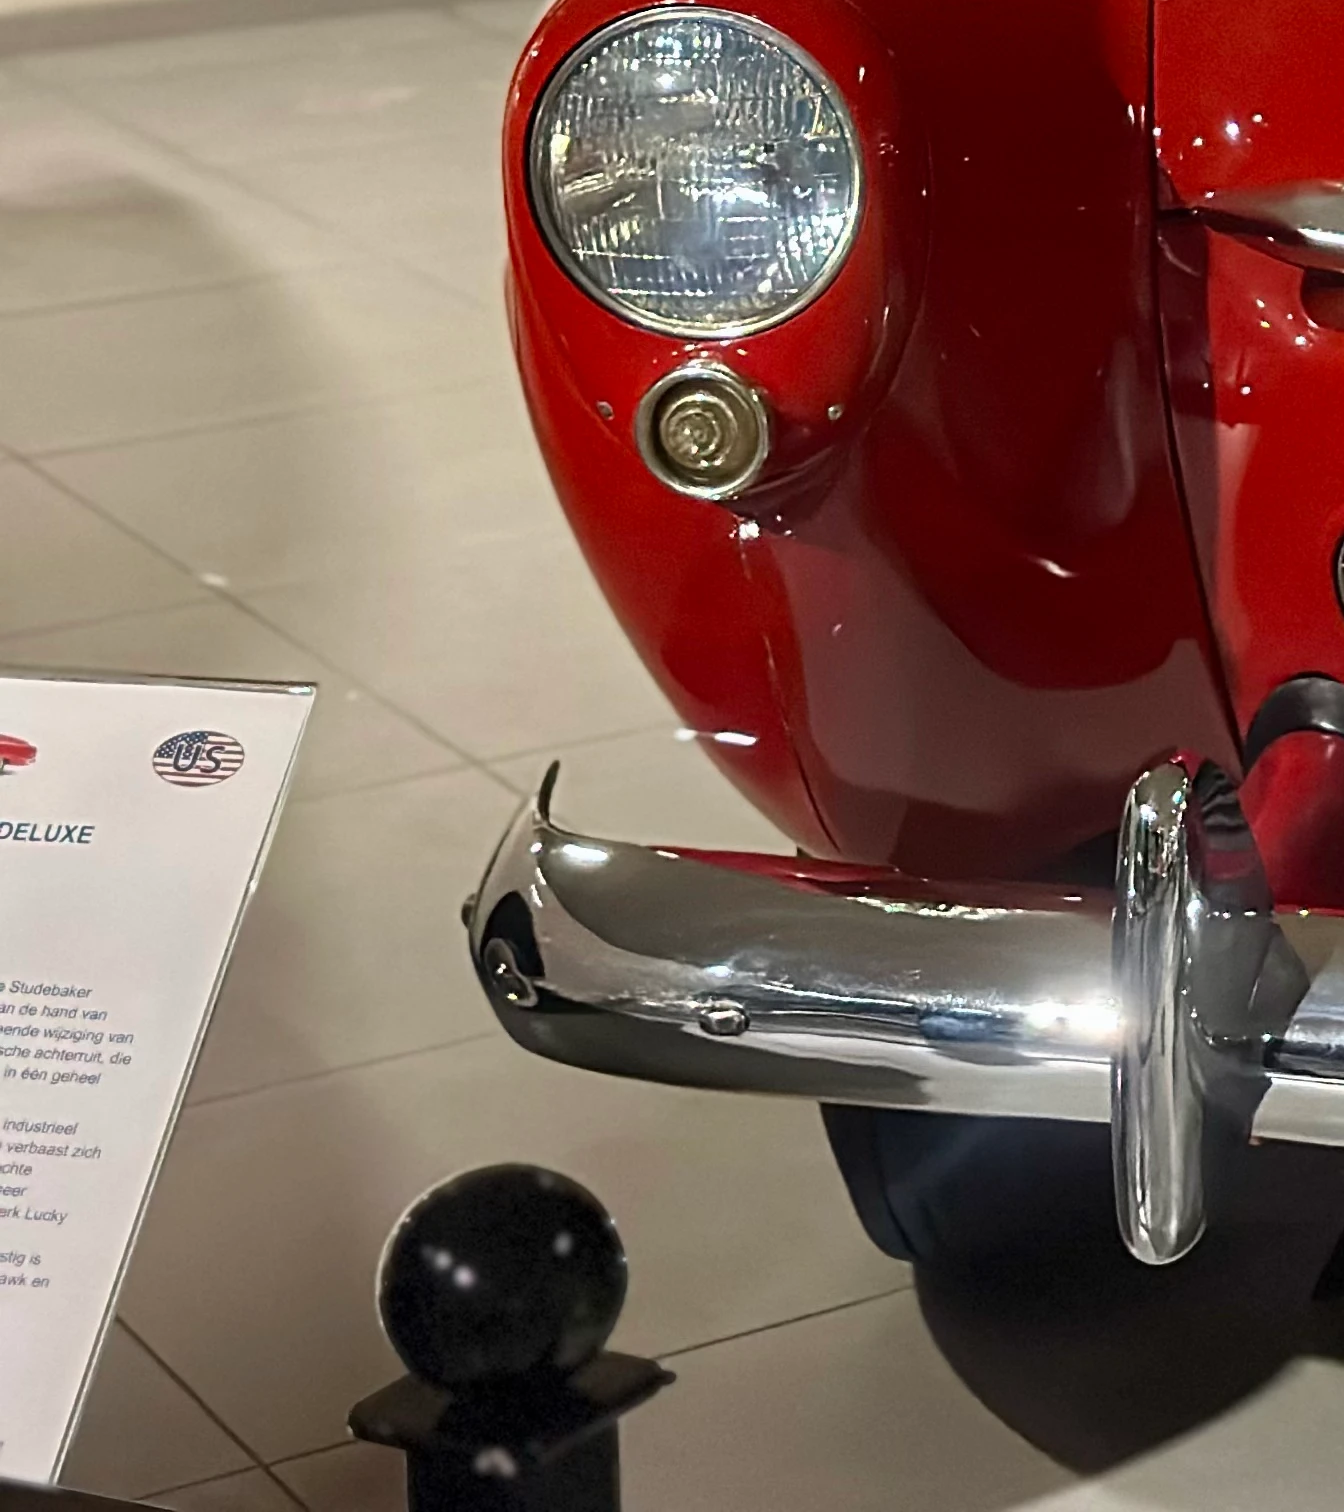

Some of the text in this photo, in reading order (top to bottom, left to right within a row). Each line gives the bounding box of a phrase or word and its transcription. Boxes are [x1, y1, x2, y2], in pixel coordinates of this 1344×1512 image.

[173, 743, 226, 774] US
[0, 821, 95, 844] DELUXE
[9, 980, 93, 998] Studebaker
[19, 1003, 37, 1016] de
[41, 1004, 78, 1019] hand
[82, 1009, 108, 1021] van
[44, 1027, 104, 1045] wijziging
[109, 1032, 134, 1044] van
[110, 1051, 132, 1066] die
[3, 1064, 16, 1078] in
[51, 1069, 101, 1085] geheel
[3, 1118, 79, 1136] industrieel
[7, 1141, 102, 1159] verbaast zich
[0, 1161, 33, 1176] chte
[25, 1206, 68, 1225] Lucky
[29, 1252, 42, 1265] is
[32, 1276, 50, 1288] en
